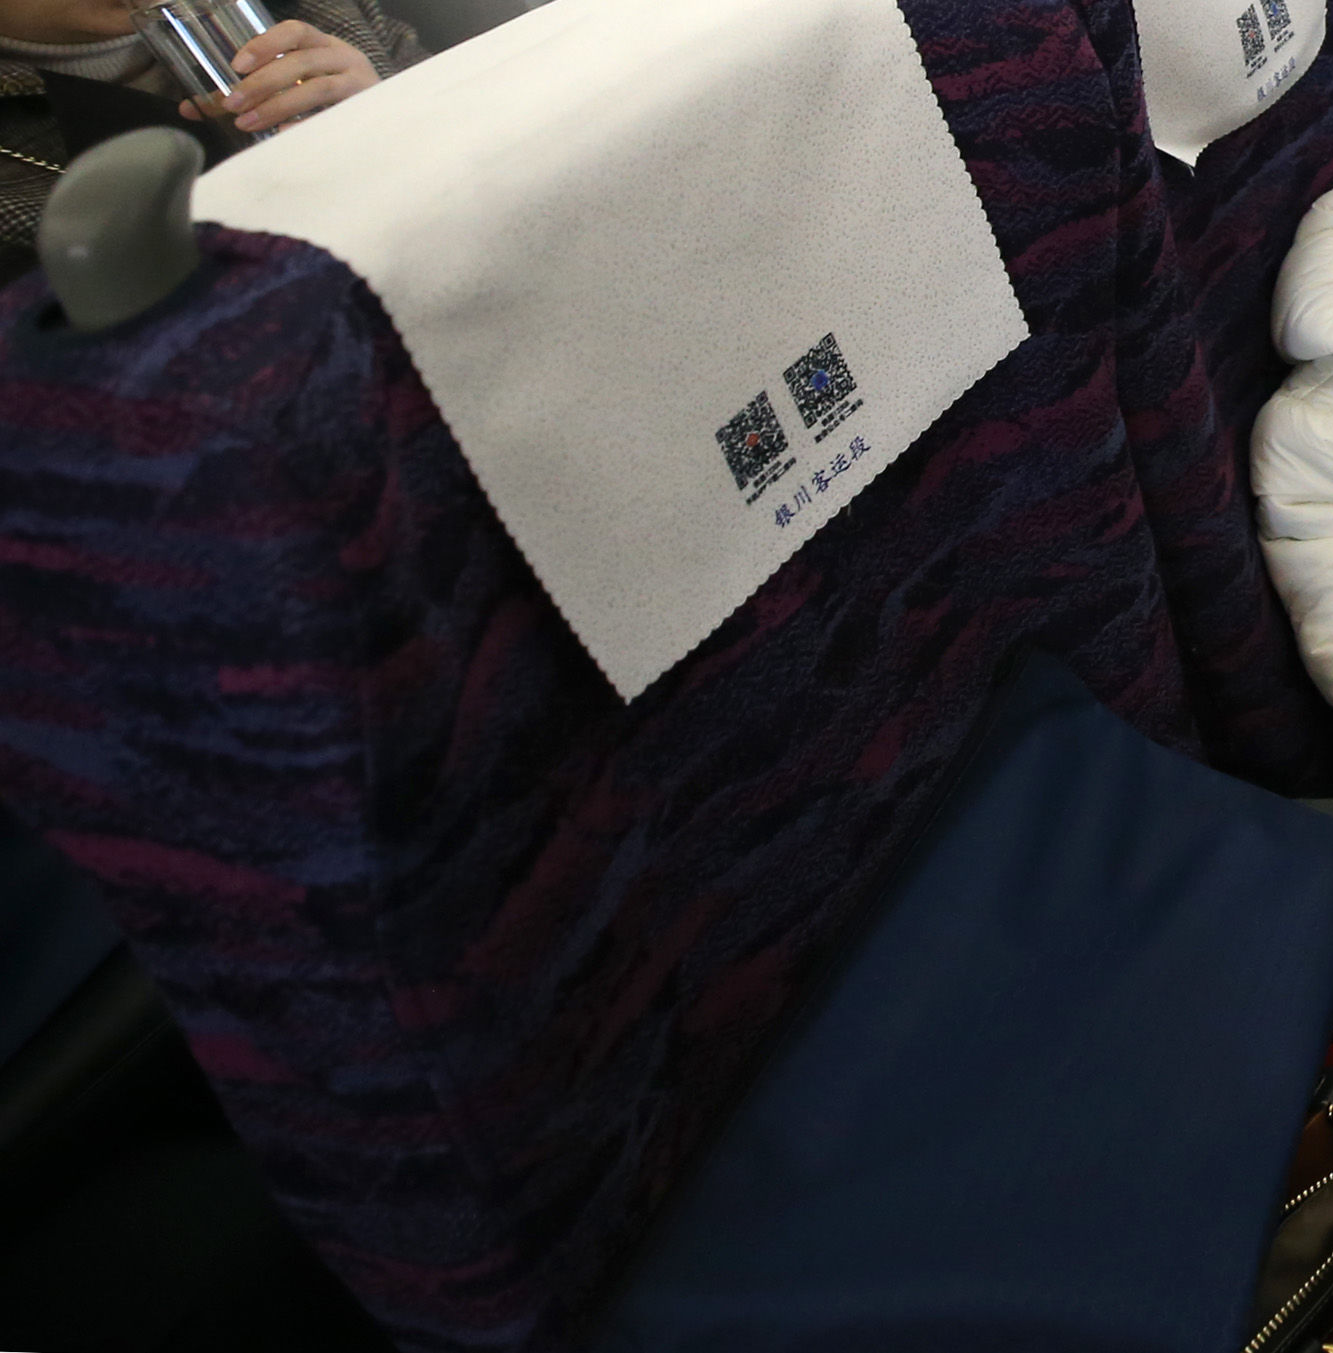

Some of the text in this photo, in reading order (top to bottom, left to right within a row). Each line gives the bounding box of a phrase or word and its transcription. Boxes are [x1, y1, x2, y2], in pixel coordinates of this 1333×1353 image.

[775, 436, 872, 529] 银川客运段
